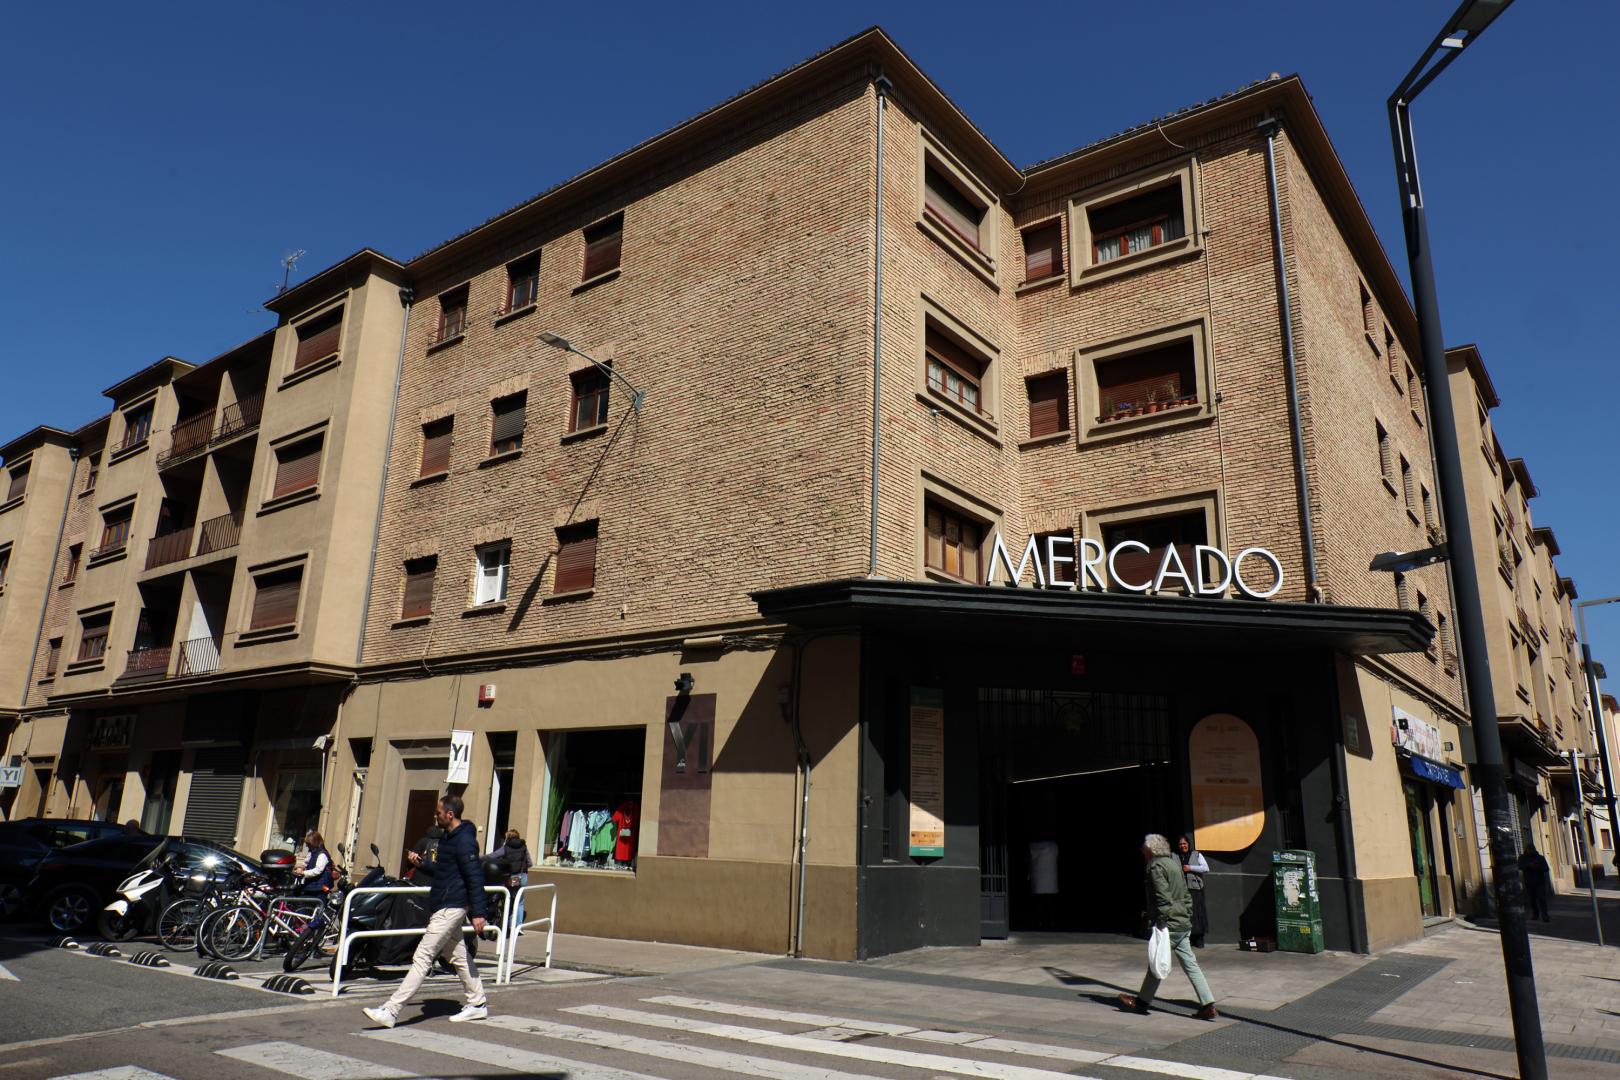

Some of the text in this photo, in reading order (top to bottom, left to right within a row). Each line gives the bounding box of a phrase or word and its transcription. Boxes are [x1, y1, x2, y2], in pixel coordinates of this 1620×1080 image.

[986, 531, 1283, 598] MERCADO
[452, 743, 469, 762] YI
[3, 770, 18, 781] YI
